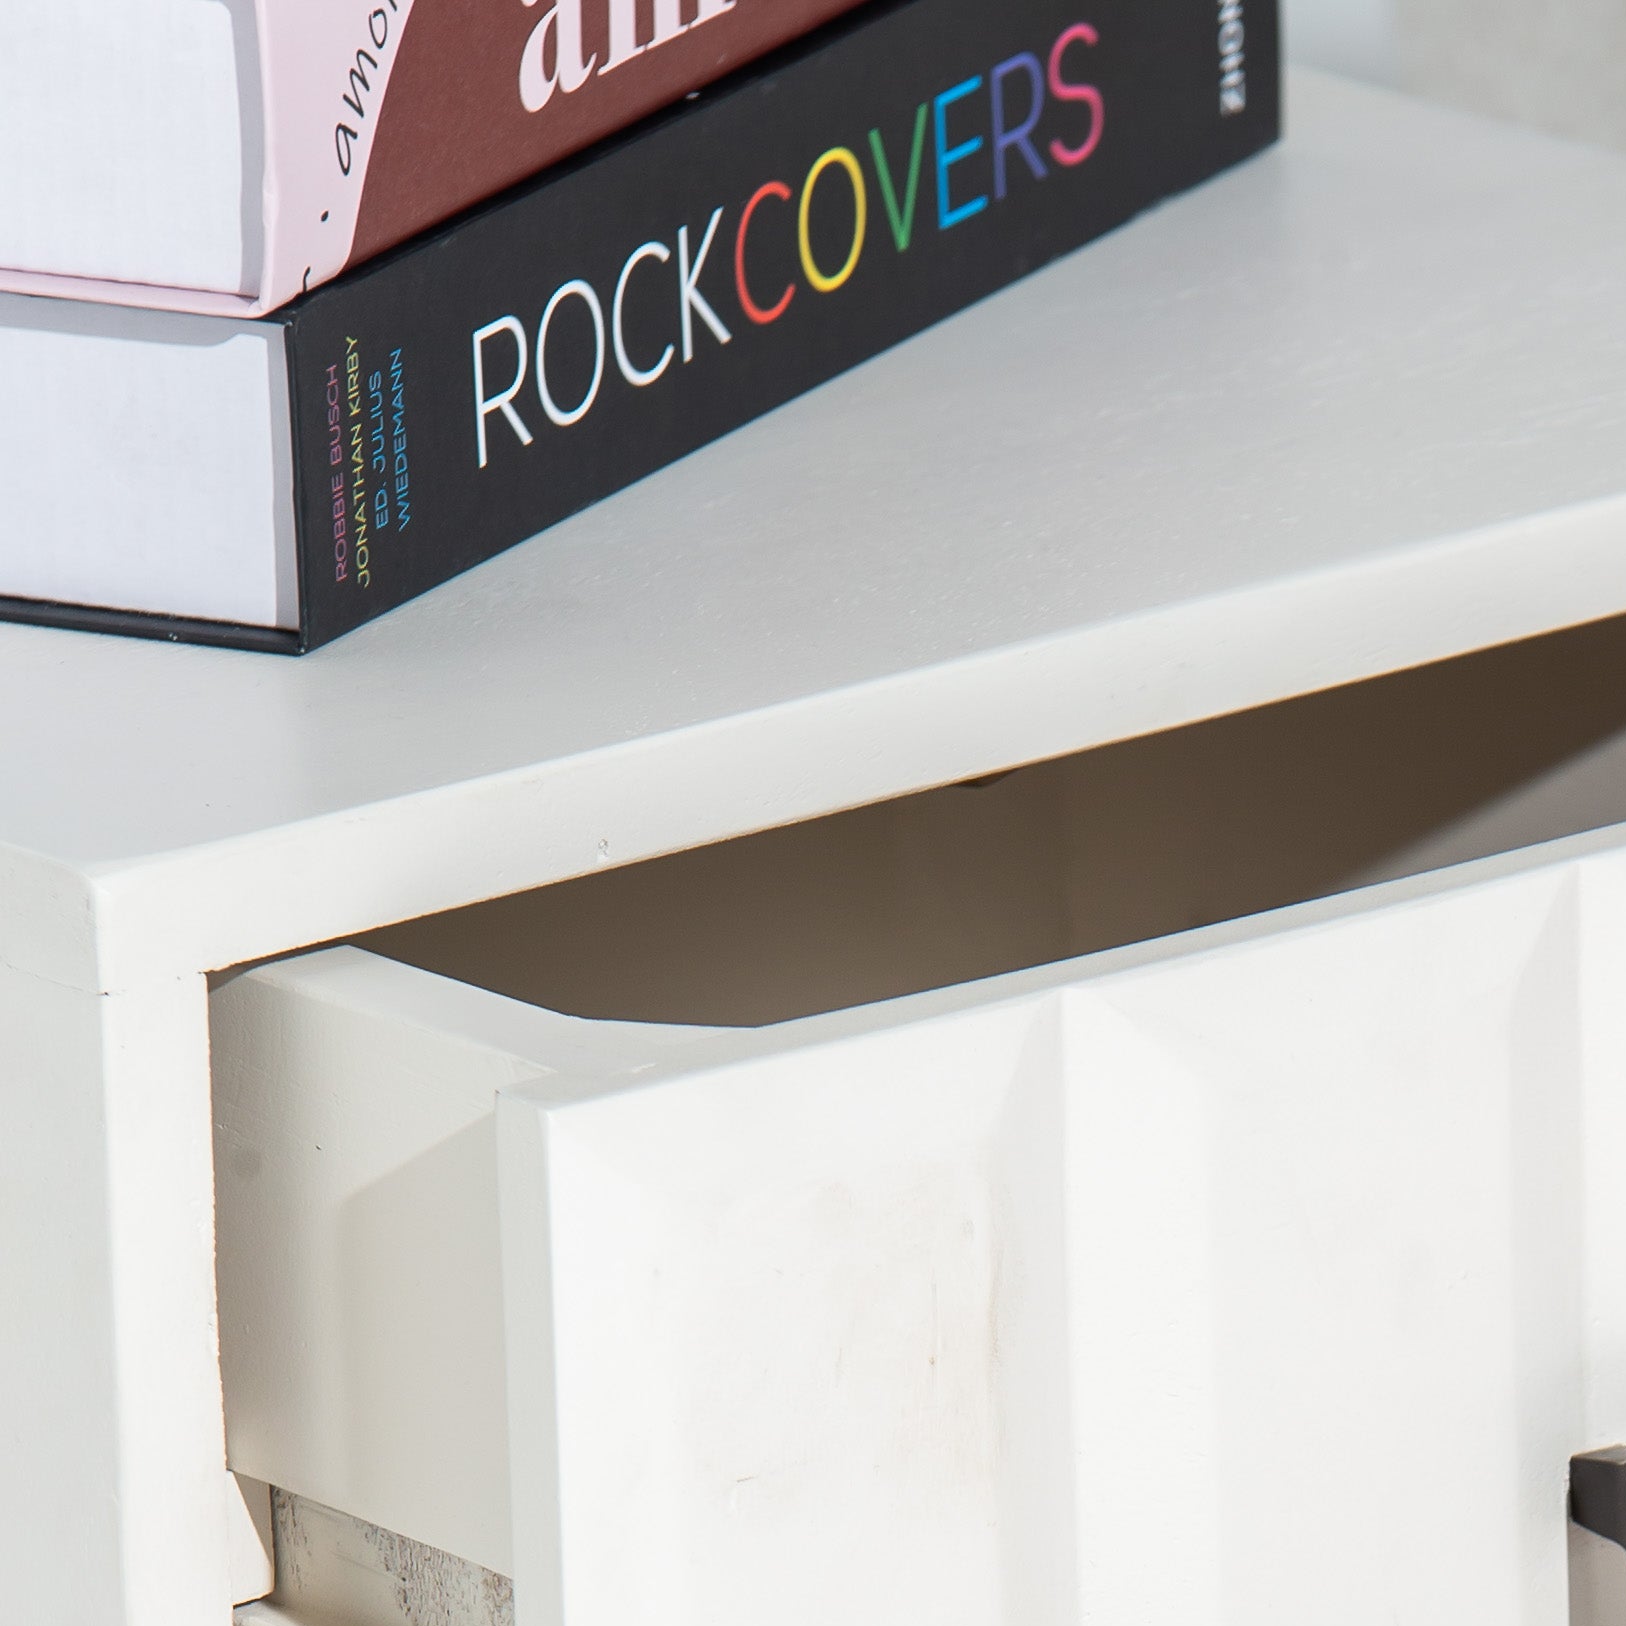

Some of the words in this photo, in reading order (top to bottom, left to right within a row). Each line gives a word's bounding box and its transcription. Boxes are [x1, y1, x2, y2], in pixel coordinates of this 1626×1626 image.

[326, 364, 343, 466] BUSCH
[346, 335, 362, 417] KIRBY
[368, 370, 386, 474] JULIUS
[390, 347, 412, 533] WIEDEMANN
[331, 472, 348, 582] ROBBIE
[350, 423, 370, 589] JONATHAN
[374, 481, 389, 530] ED.
